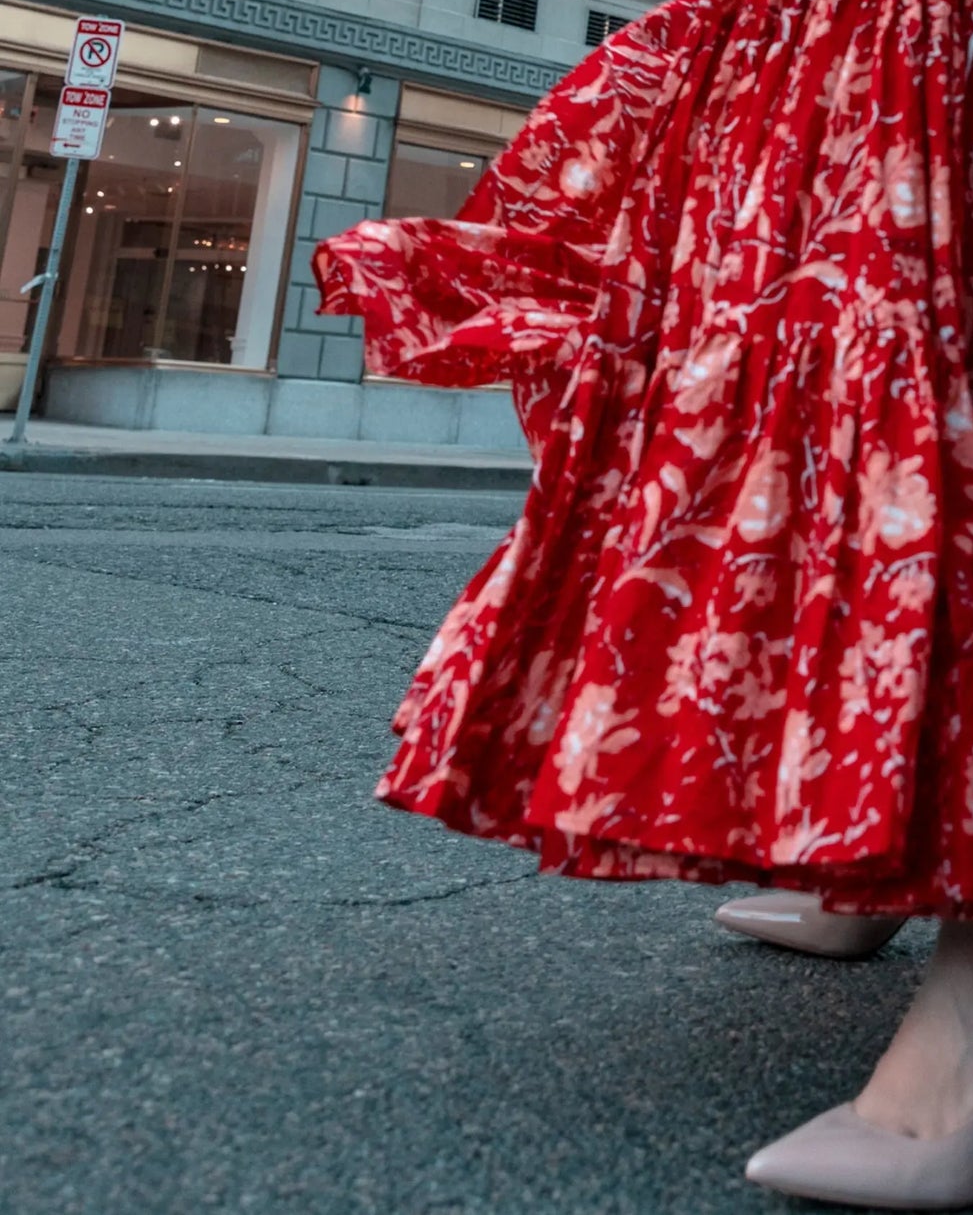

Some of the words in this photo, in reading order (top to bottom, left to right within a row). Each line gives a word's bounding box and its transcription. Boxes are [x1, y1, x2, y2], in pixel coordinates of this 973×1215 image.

[80, 21, 98, 31] TOW
[98, 22, 119, 34] ZONE
[65, 90, 83, 103] TOW
[83, 91, 106, 106] ZONE
[73, 109, 91, 119] NO
[63, 118, 98, 128] STOPPING
